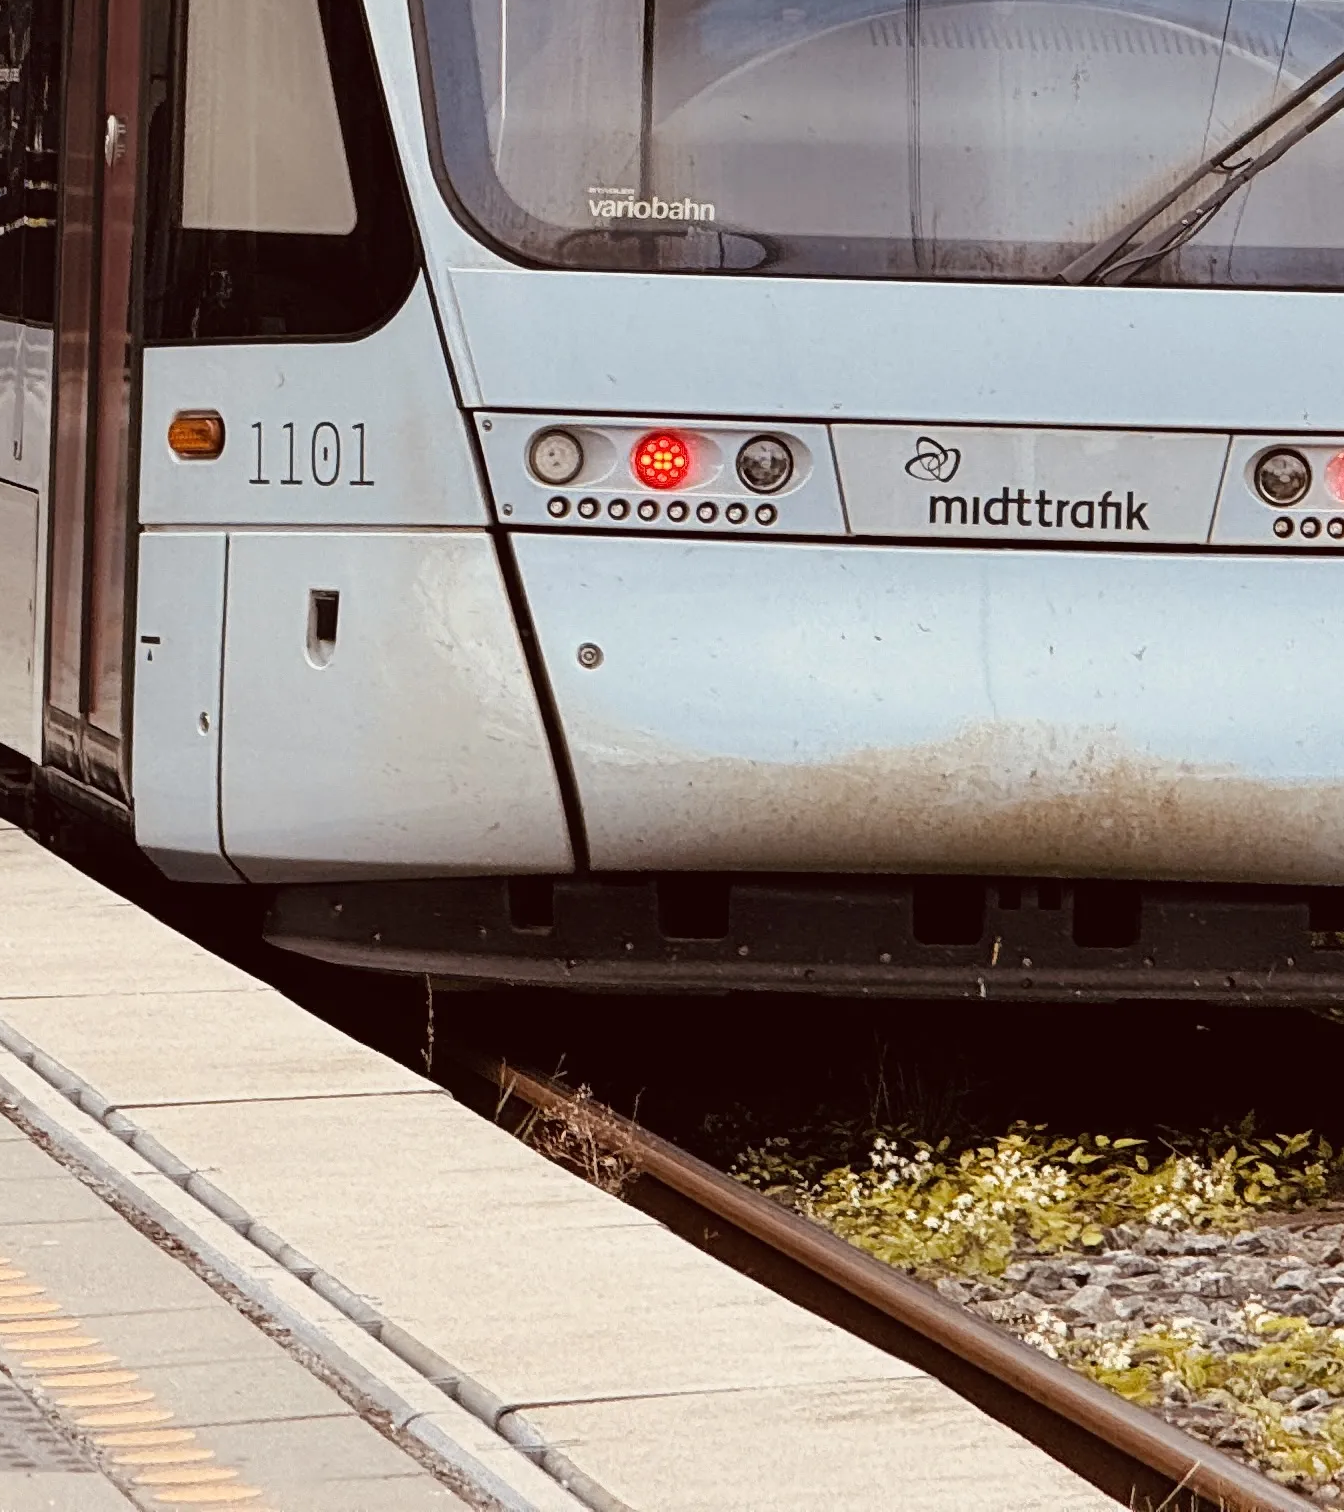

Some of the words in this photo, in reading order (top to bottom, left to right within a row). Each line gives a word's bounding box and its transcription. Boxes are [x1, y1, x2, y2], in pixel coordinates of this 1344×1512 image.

[589, 195, 716, 221] variobahn
[248, 420, 375, 487] 1101
[929, 486, 1150, 531] midttrafik
